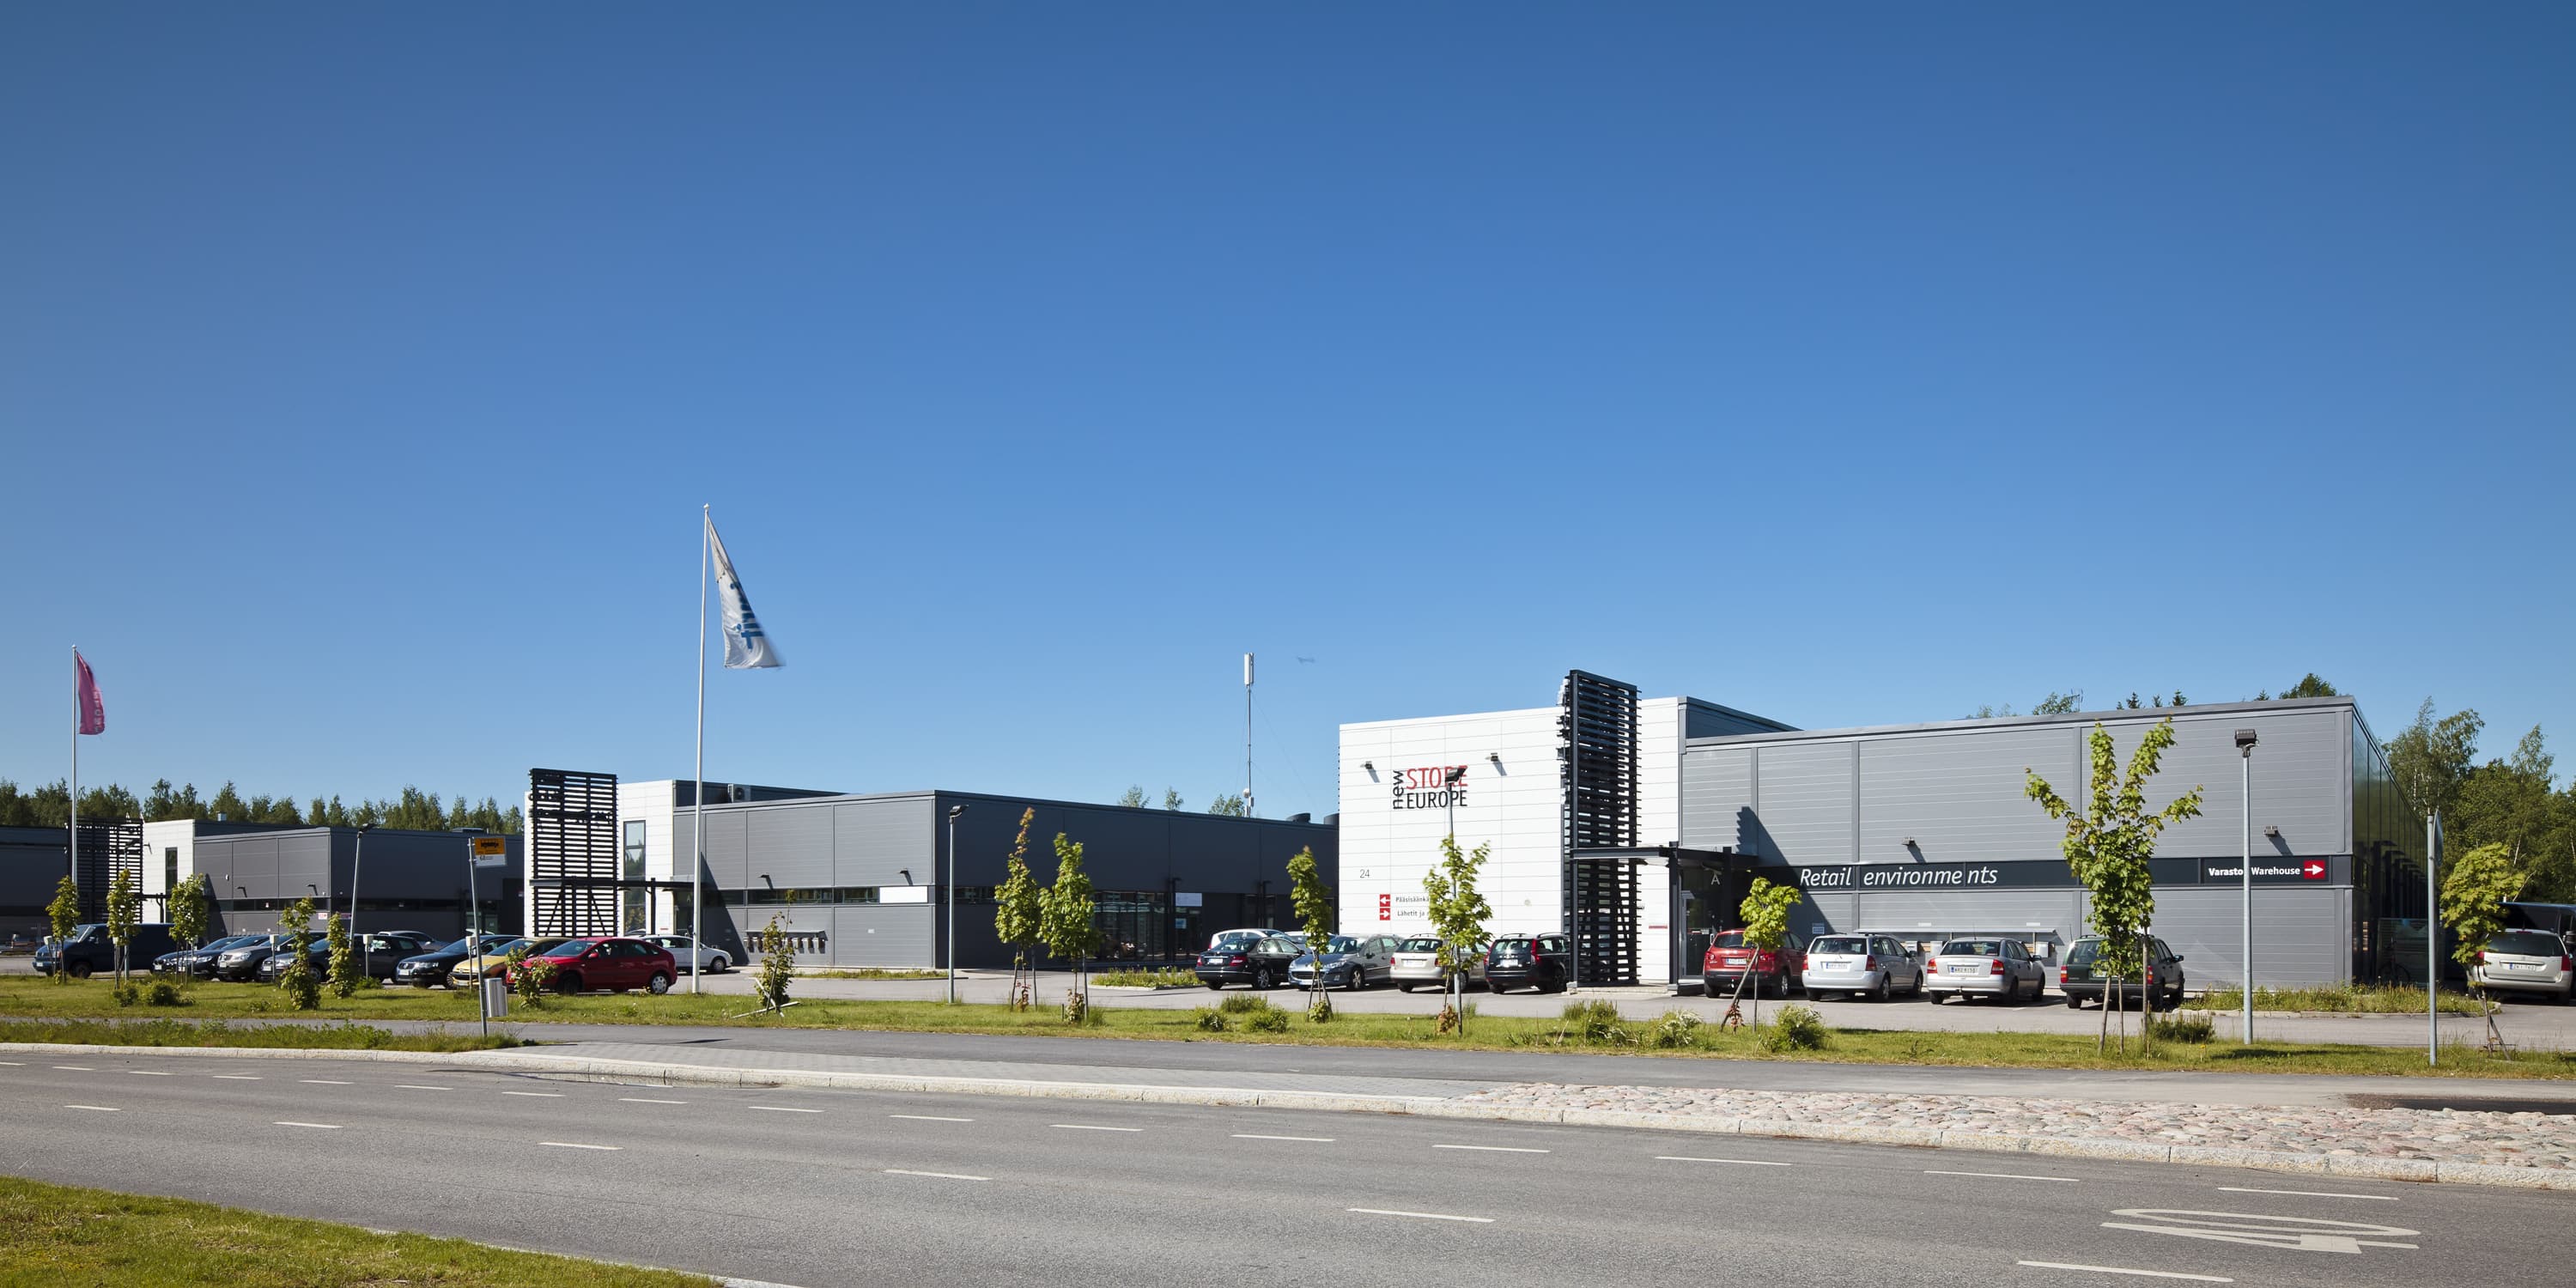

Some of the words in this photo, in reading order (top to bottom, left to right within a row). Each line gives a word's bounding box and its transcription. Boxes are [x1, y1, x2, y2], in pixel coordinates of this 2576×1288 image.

[1393, 770, 1404, 809] new
[1406, 790, 1468, 810] EUROPE
[1359, 868, 1370, 878] 24
[1710, 873, 1721, 885] A
[1800, 866, 1852, 886] Retail
[2208, 867, 2245, 877] Varasto
[2251, 866, 2301, 876] Warehouse
